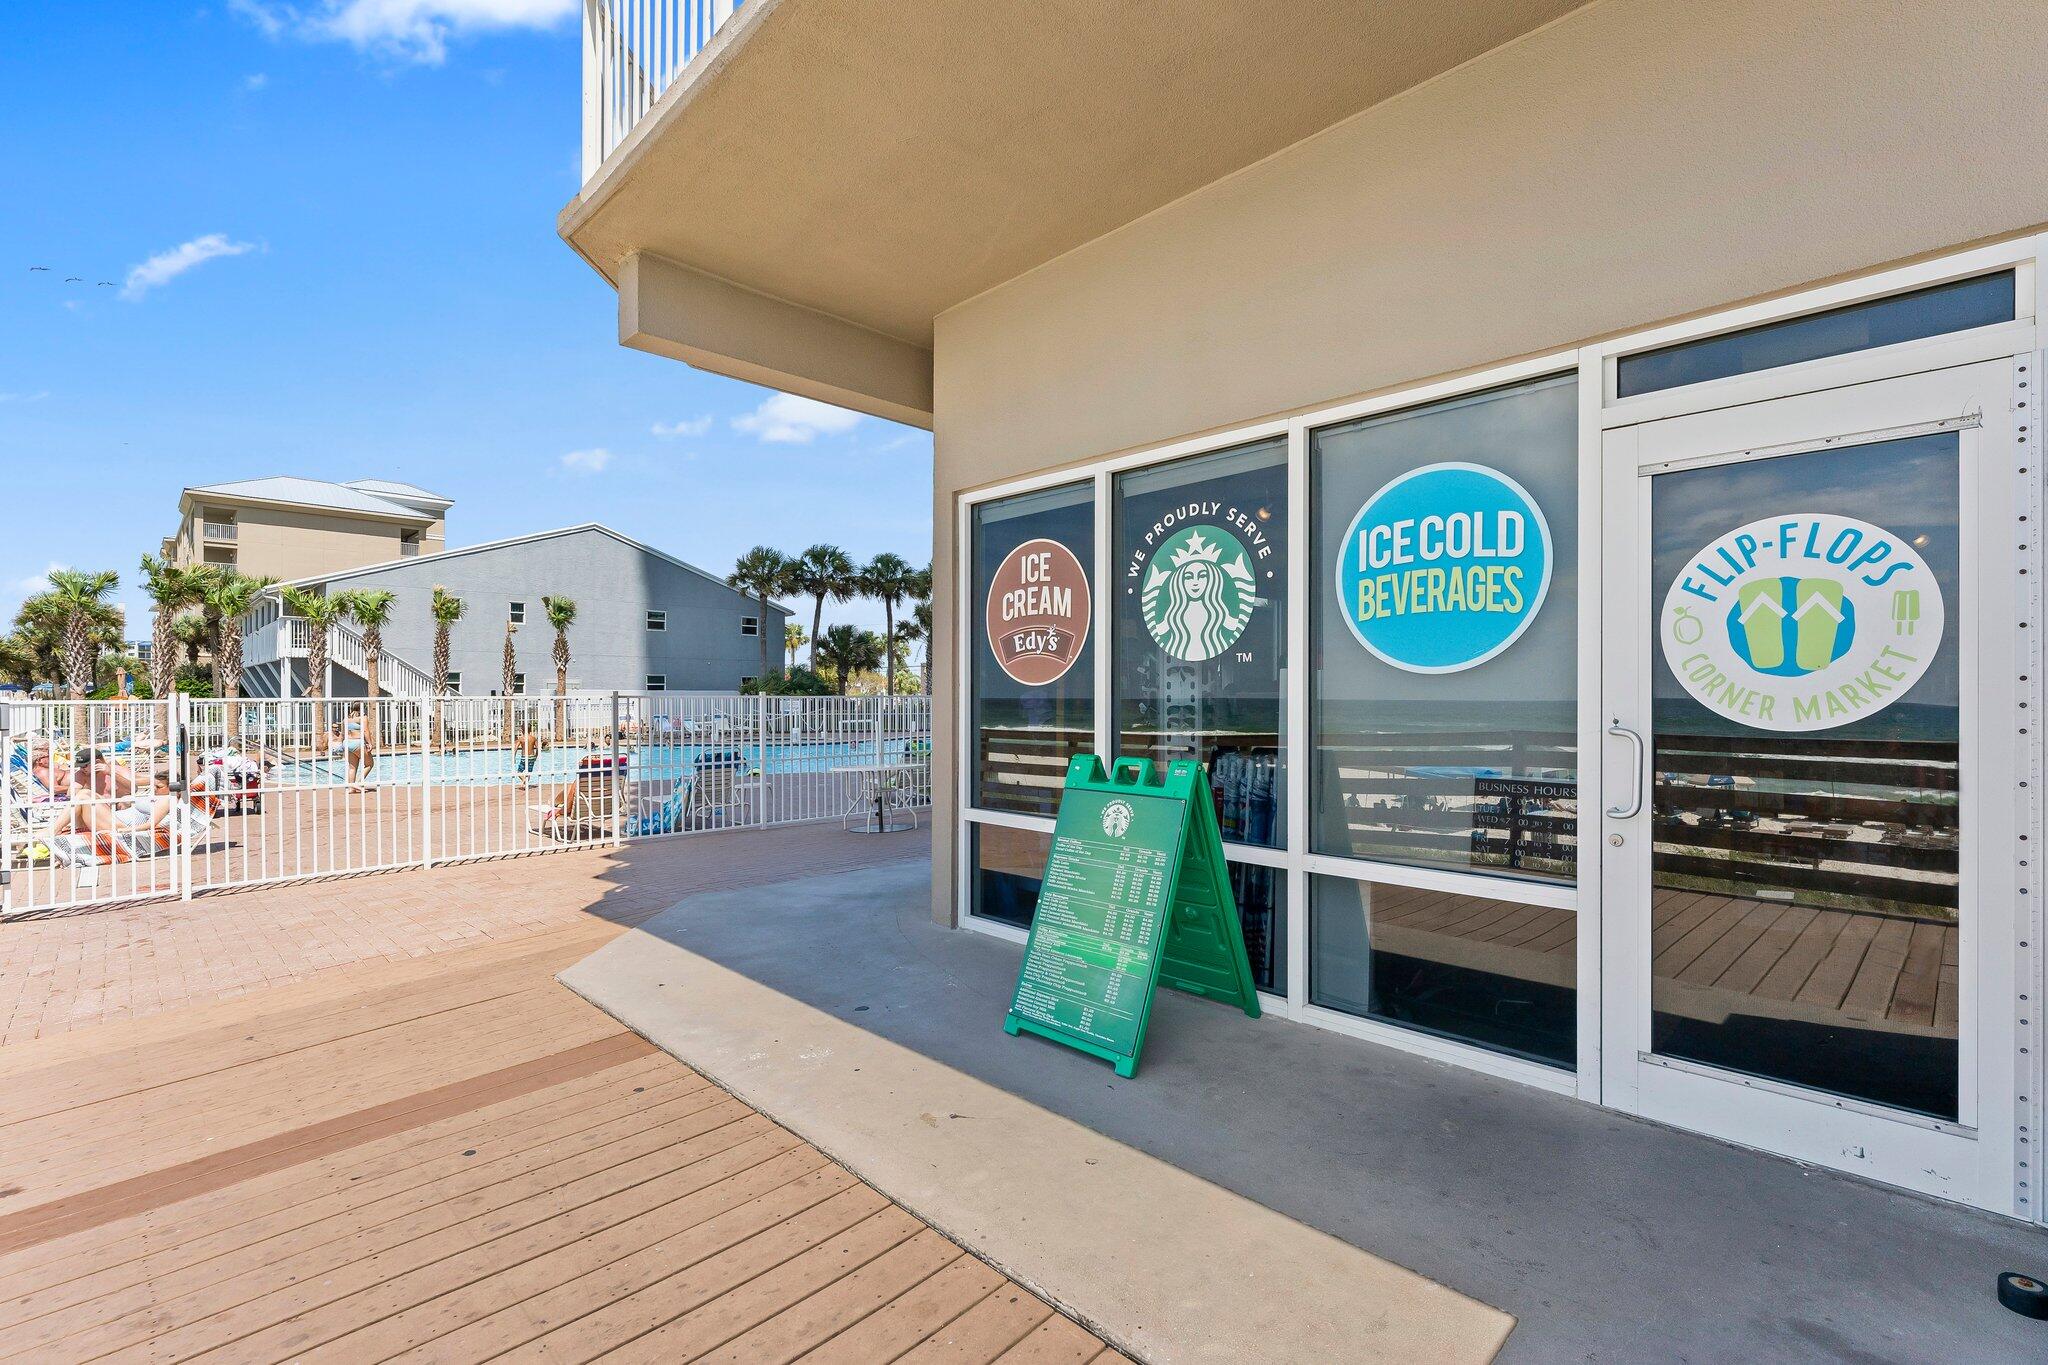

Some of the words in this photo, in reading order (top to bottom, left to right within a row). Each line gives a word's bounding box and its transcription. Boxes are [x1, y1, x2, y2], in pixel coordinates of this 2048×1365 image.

[1128, 549, 1146, 578] WE
[1144, 501, 1221, 545] PROUDLY
[1226, 507, 1272, 560] SERVE
[1358, 518, 1415, 573] ICE
[1419, 510, 1525, 562] COLD
[1021, 552, 1052, 584] ICE
[1681, 521, 1915, 603] FLIP-FLOPS
[1002, 585, 1072, 622] CREAM
[1358, 565, 1524, 622] BEVERAGES
[1013, 627, 1059, 655] Edy's
[1236, 652, 1252, 663] TM
[1681, 652, 1776, 722] CORNER
[1792, 644, 1918, 723] MARKET
[1479, 781, 1529, 795] BUSINESS
[1534, 785, 1577, 798] HOURS
[1477, 815, 1498, 824] WED
[1518, 819, 1529, 827] 00
[1563, 823, 1574, 831] 00
[1475, 844, 1491, 853] SAT
[1515, 849, 1526, 857] 00
[1516, 839, 1528, 847] 00
